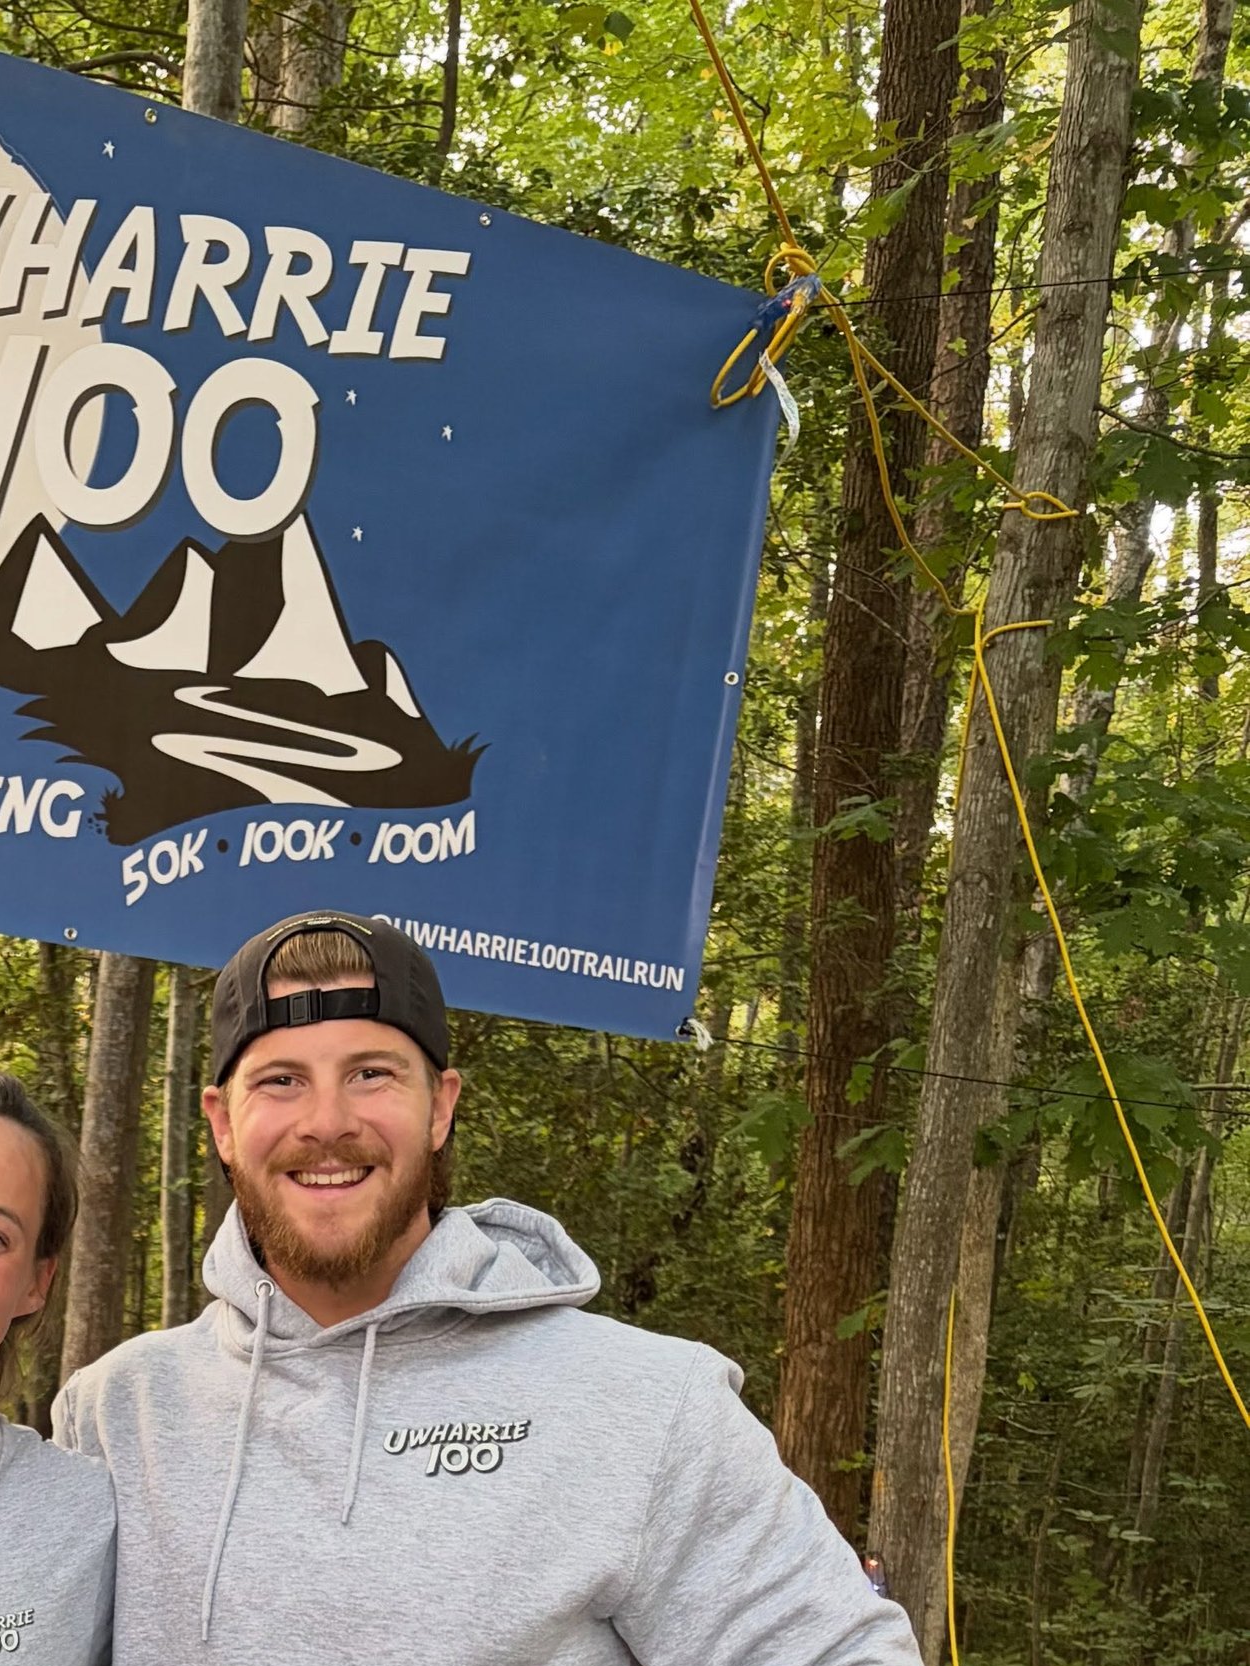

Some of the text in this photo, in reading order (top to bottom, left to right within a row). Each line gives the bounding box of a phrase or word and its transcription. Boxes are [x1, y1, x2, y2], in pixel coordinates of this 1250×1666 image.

[122, 810, 476, 906] 50K 100K 100M
[371, 914, 685, 992] WHARRIE100TRAILRUN
[383, 1420, 532, 1455] UWHARRIE
[426, 1442, 504, 1477] 100
